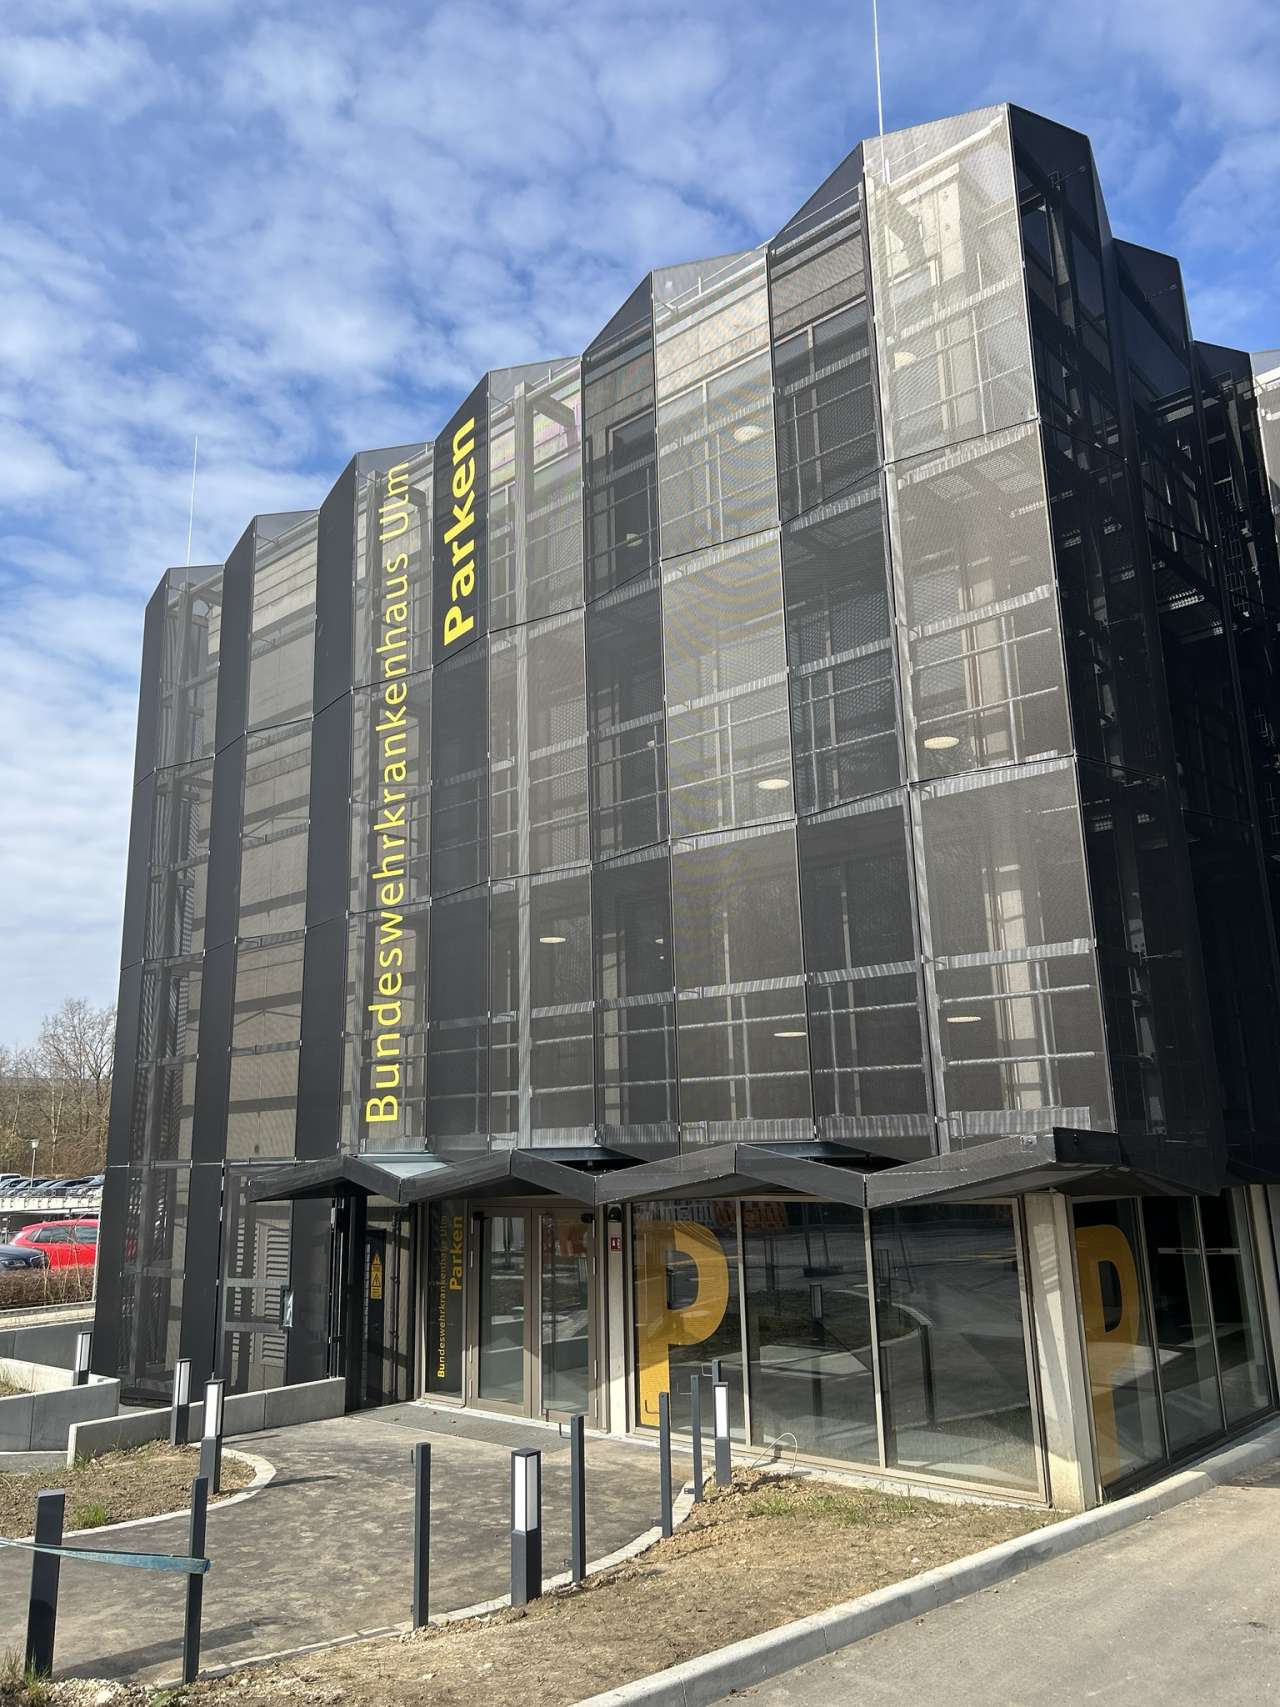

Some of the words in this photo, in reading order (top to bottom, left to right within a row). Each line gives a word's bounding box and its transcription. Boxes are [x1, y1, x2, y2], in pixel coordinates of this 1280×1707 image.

[378, 462, 410, 542] Ulm
[443, 416, 476, 647] Parken
[364, 553, 409, 1123] Bundeswehrkrankenhaus
[448, 1215, 463, 1291] Parken
[635, 1220, 730, 1427] P
[1075, 1223, 1141, 1487] P
